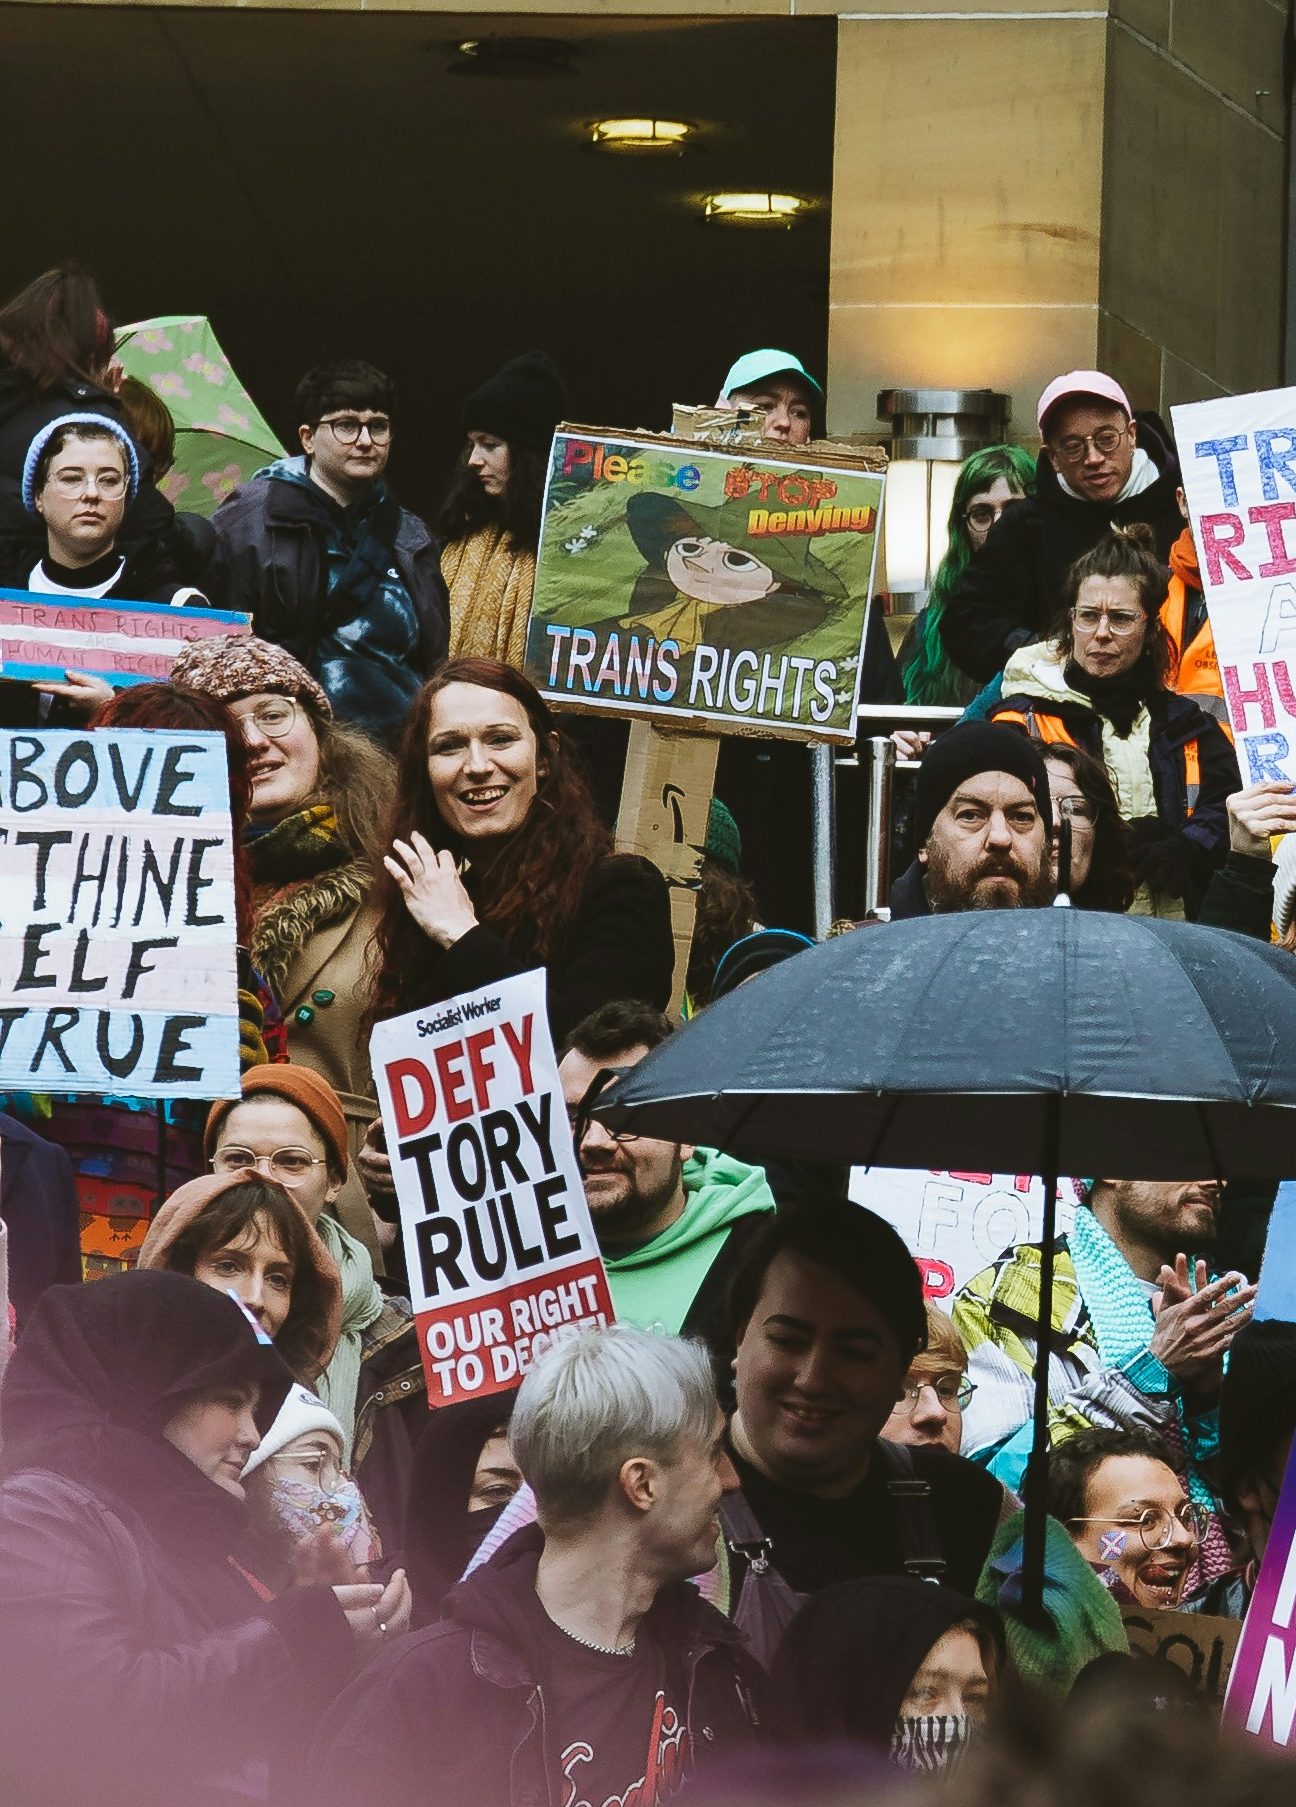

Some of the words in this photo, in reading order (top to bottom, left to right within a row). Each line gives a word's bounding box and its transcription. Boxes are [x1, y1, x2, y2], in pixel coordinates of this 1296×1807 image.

[563, 438, 701, 492] Please
[723, 464, 838, 509] STOP
[747, 504, 877, 539] Denying
[3, 641, 85, 667] HUMAN
[11, 605, 98, 631] TRANS
[114, 614, 200, 640] RIGHTS
[546, 624, 681, 702] TRANS
[688, 645, 838, 723] RIGHTS
[0, 736, 208, 817] BOVE
[15, 830, 225, 929] THINE
[0, 922, 180, 1000] ELF
[416, 1007, 464, 1039] Socialist
[462, 996, 502, 1026] Worker
[384, 1013, 535, 1140] DEFY
[398, 1091, 559, 1215] TORY
[415, 1174, 582, 1299] RULE
[426, 1308, 506, 1360] OUR
[510, 1275, 599, 1336] RIGHT
[431, 1352, 487, 1397] TO
